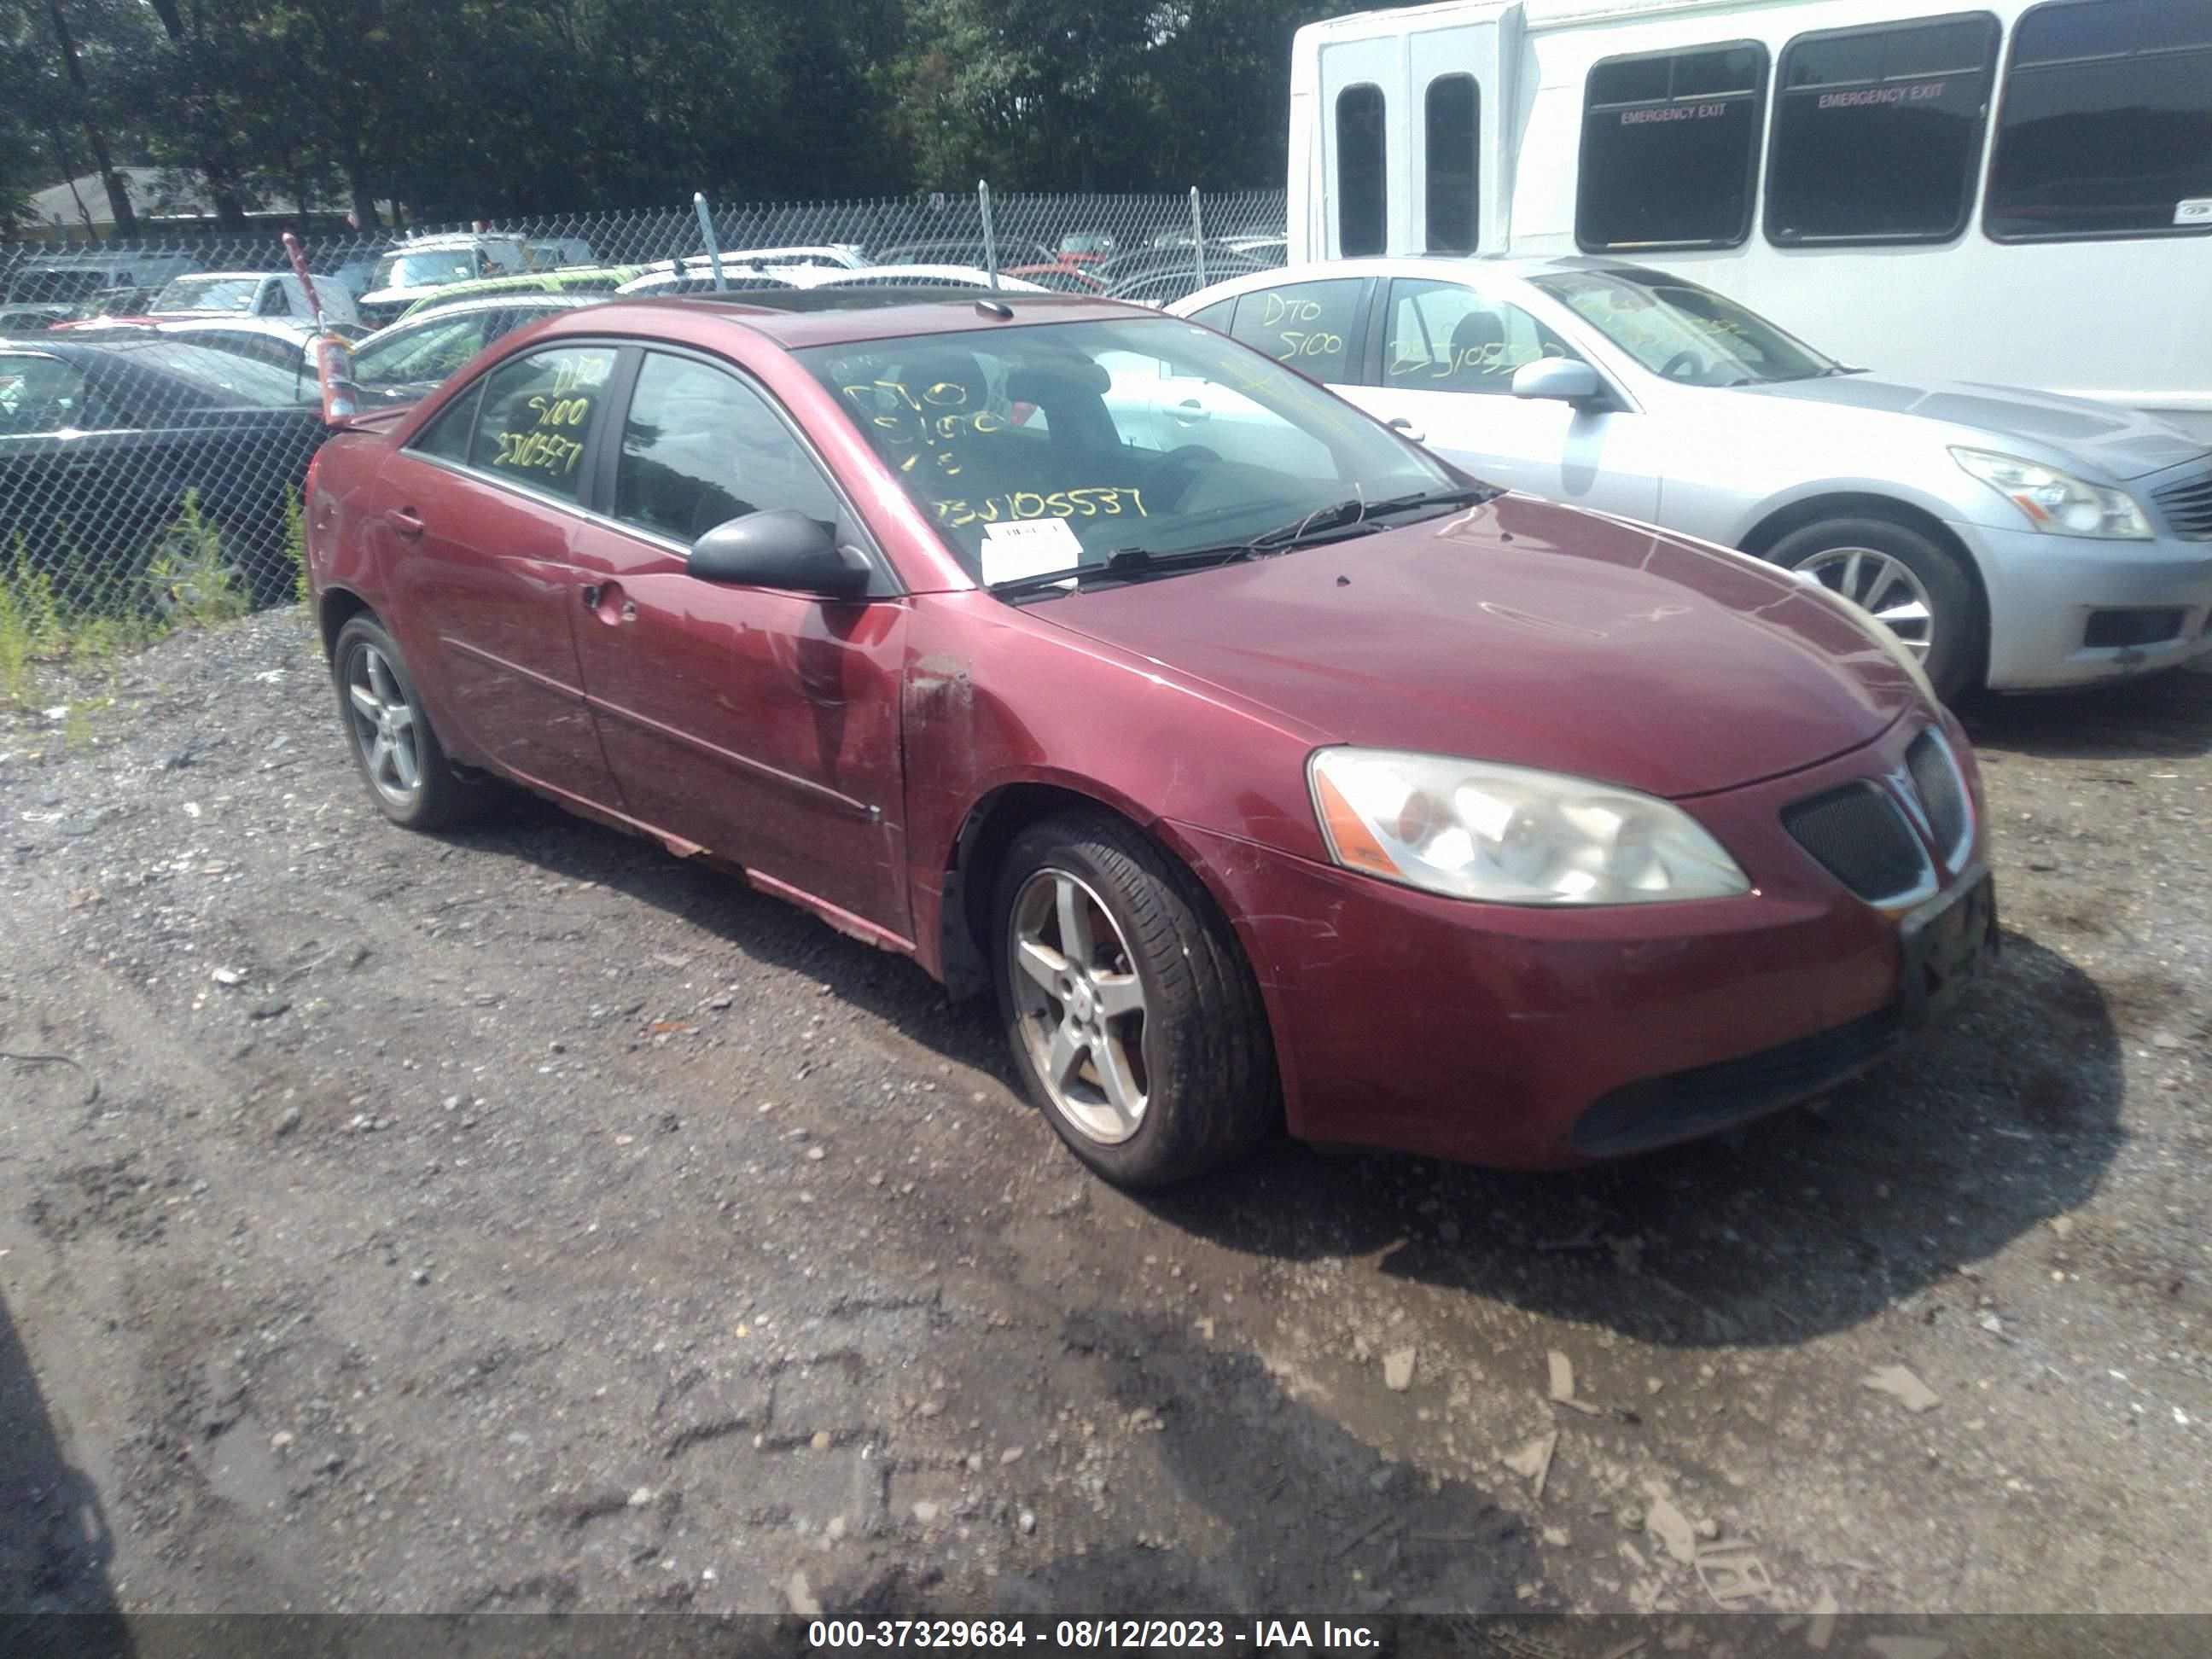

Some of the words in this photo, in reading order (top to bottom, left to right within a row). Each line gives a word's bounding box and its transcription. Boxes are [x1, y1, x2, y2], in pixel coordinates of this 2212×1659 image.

[1819, 87, 1907, 109] EMERGENCY
[1910, 83, 1945, 100] EXIT
[1621, 106, 1696, 125] EMERGENCY
[1698, 102, 1727, 118] EXIT
[1263, 293, 1321, 326] DTO
